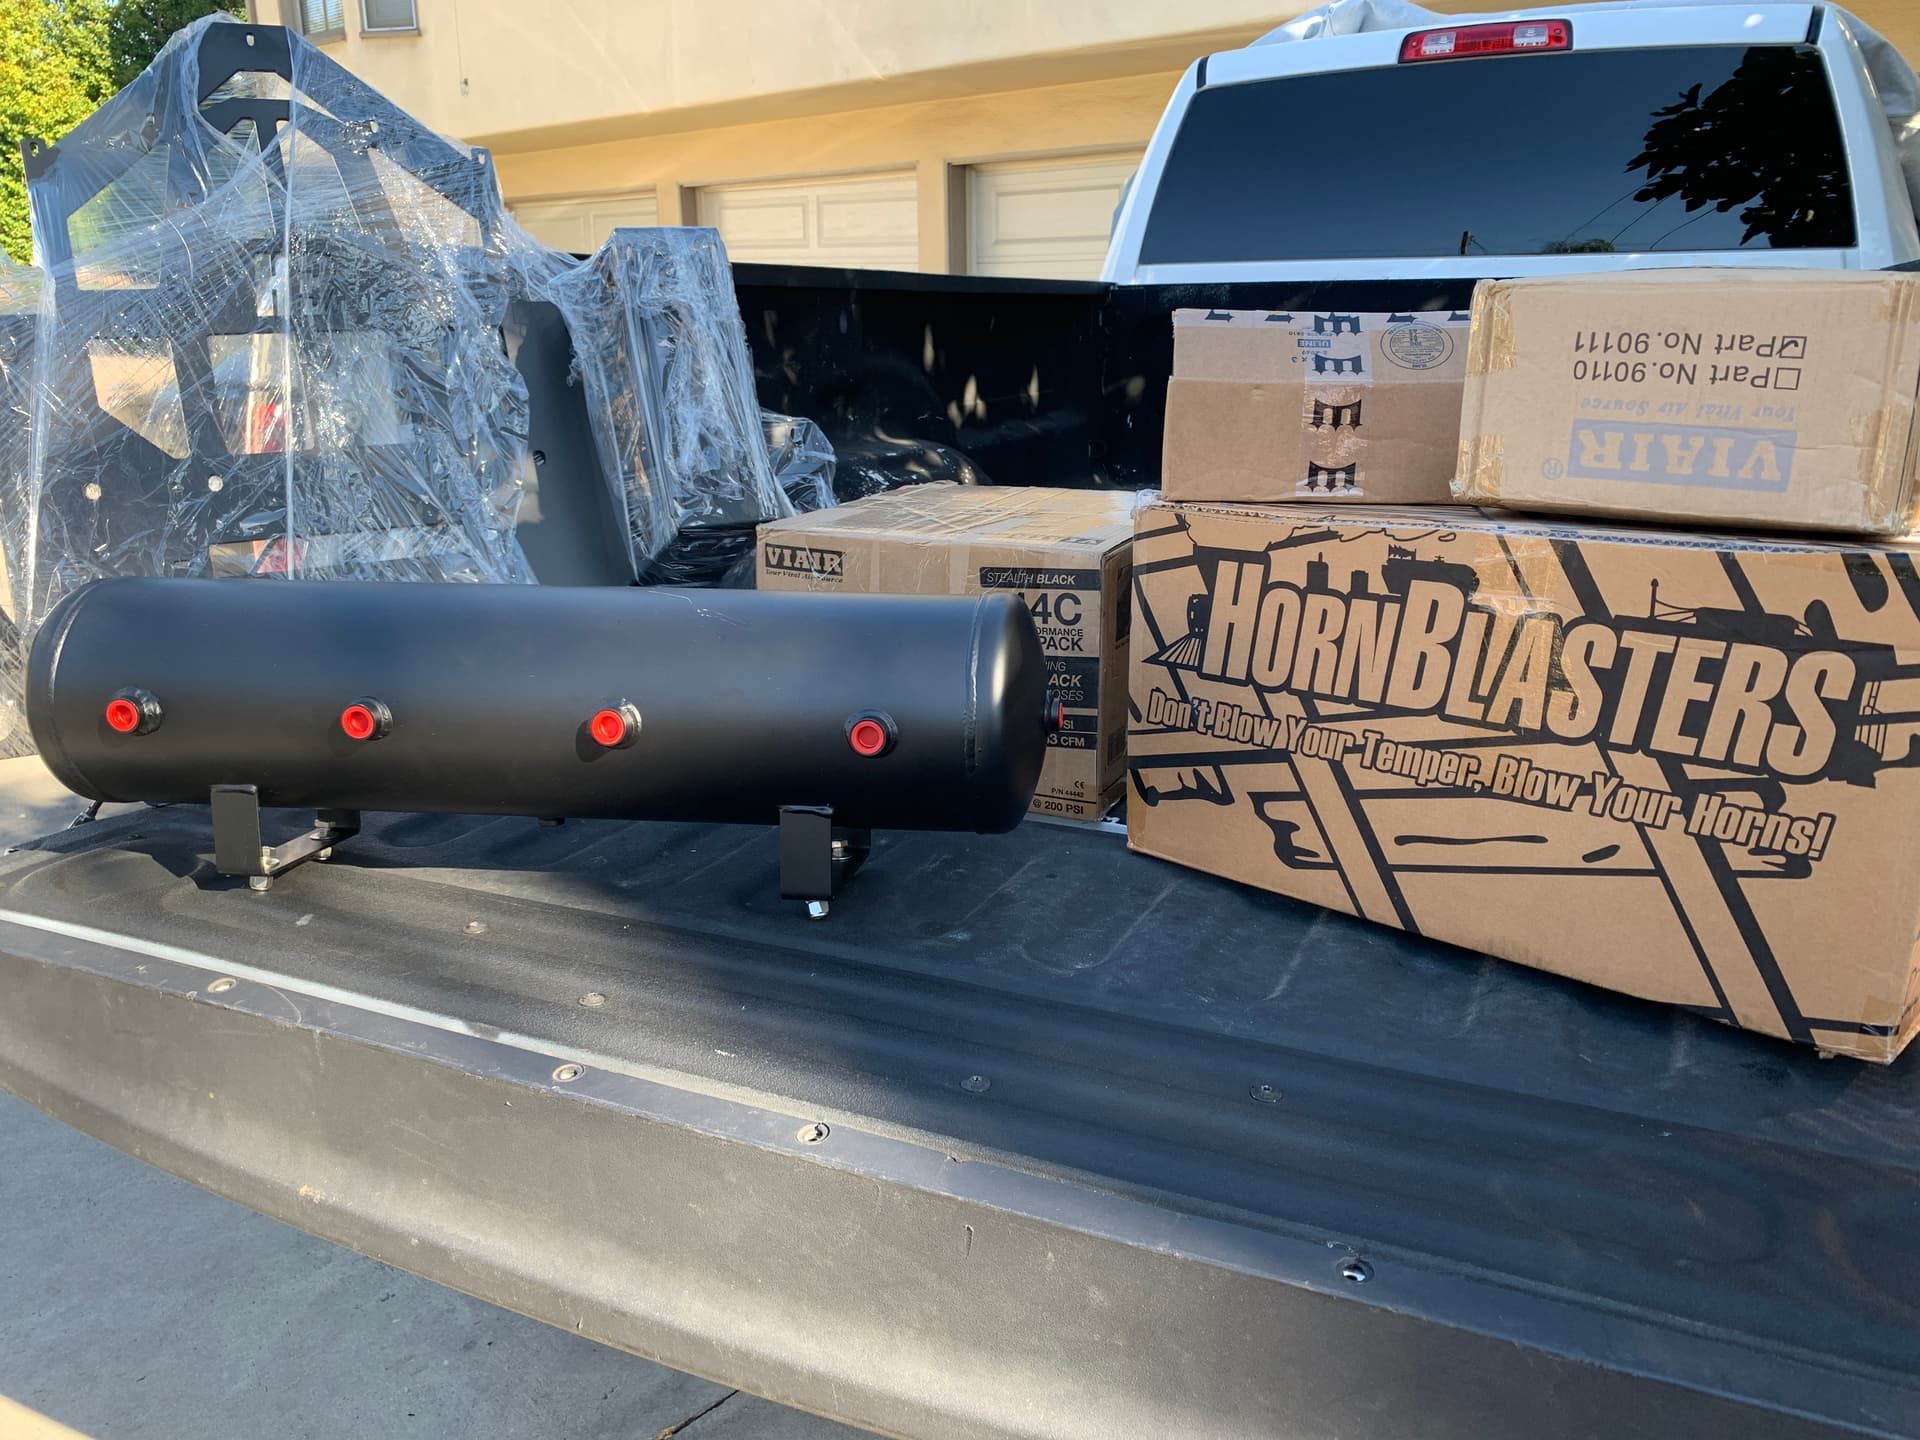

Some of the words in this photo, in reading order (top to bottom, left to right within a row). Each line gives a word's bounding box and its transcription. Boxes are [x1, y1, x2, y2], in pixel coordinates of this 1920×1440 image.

[1714, 333, 1777, 357] Part
[1709, 364, 1771, 389] Part
[1580, 397, 1649, 416] Source
[1657, 401, 1688, 416] Air
[1695, 403, 1742, 420] Vital
[1752, 406, 1796, 422] Your
[1577, 429, 1782, 481] VIAIR
[765, 545, 843, 573] VIAIR
[986, 572, 1034, 584] STEALTH
[1036, 574, 1077, 585] BLACK
[1045, 661, 1067, 672] ING
[1048, 673, 1083, 687] ACK
[1049, 688, 1084, 701] OSES
[1060, 735, 1085, 747] CFM
[1147, 688, 1213, 738] Don't
[1211, 701, 1282, 750] Blow
[1283, 713, 1355, 763] Your
[1360, 728, 1486, 794] Temper,
[1492, 752, 1586, 812] Blow
[1589, 770, 1684, 831] Your
[1685, 790, 1837, 862] Horns!
[1044, 801, 1063, 812] 200
[1066, 803, 1084, 815] PSI
